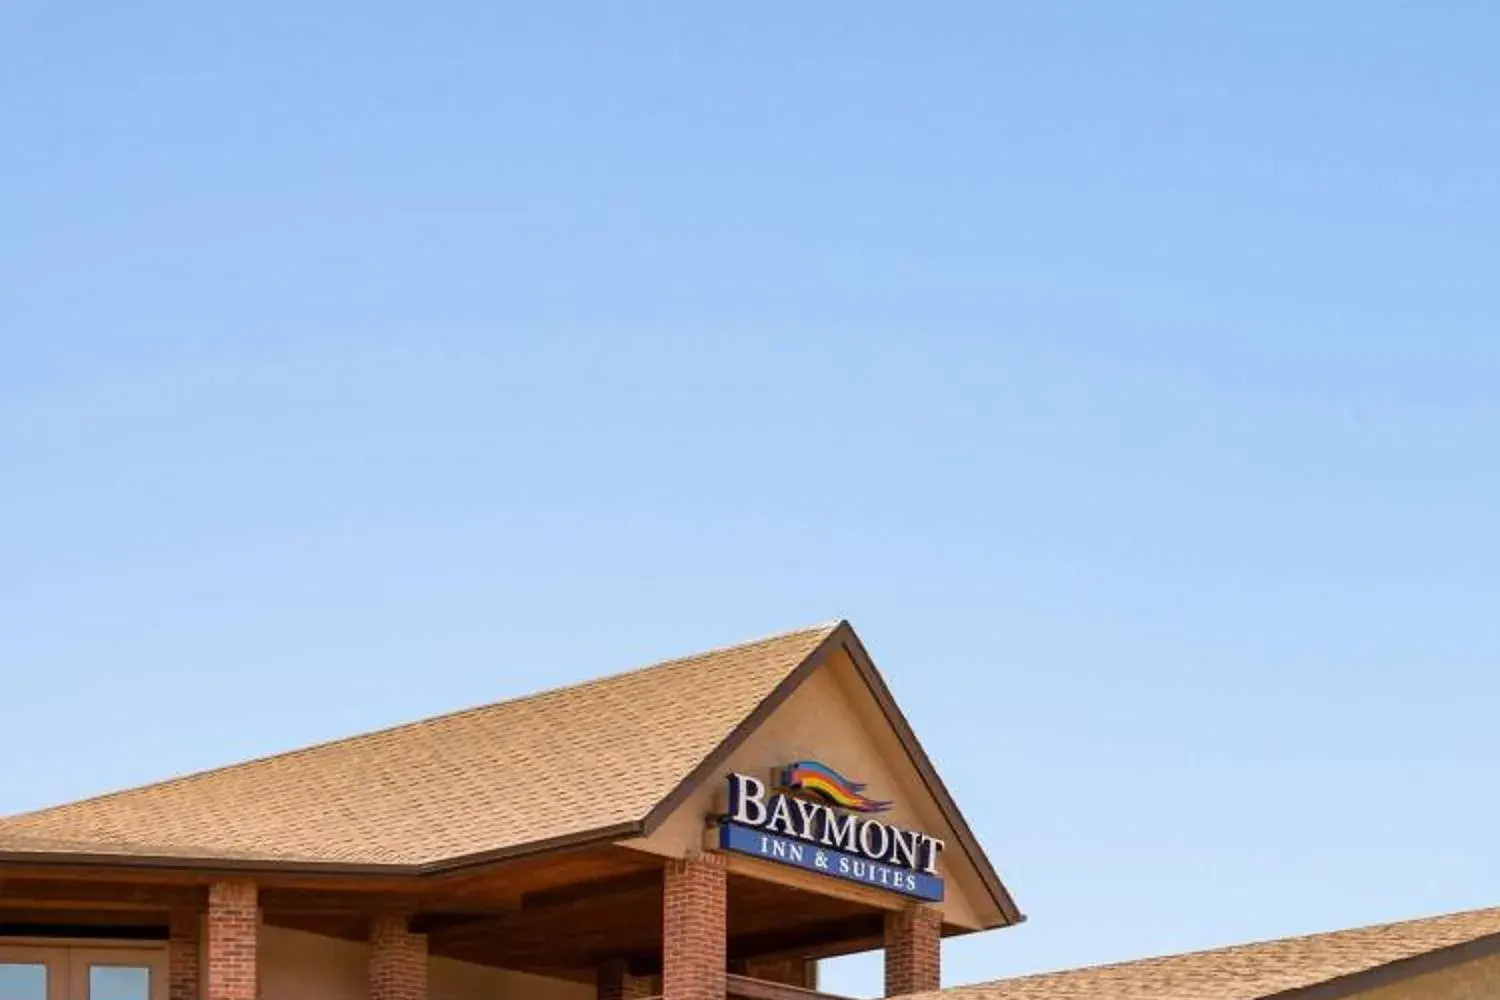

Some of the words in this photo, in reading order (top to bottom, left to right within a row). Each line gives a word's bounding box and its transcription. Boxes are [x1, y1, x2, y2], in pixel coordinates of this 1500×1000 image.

[732, 772, 945, 876] BAYMONT
[760, 837, 803, 862] INN
[814, 850, 829, 869] &
[839, 857, 917, 891] SUITES
